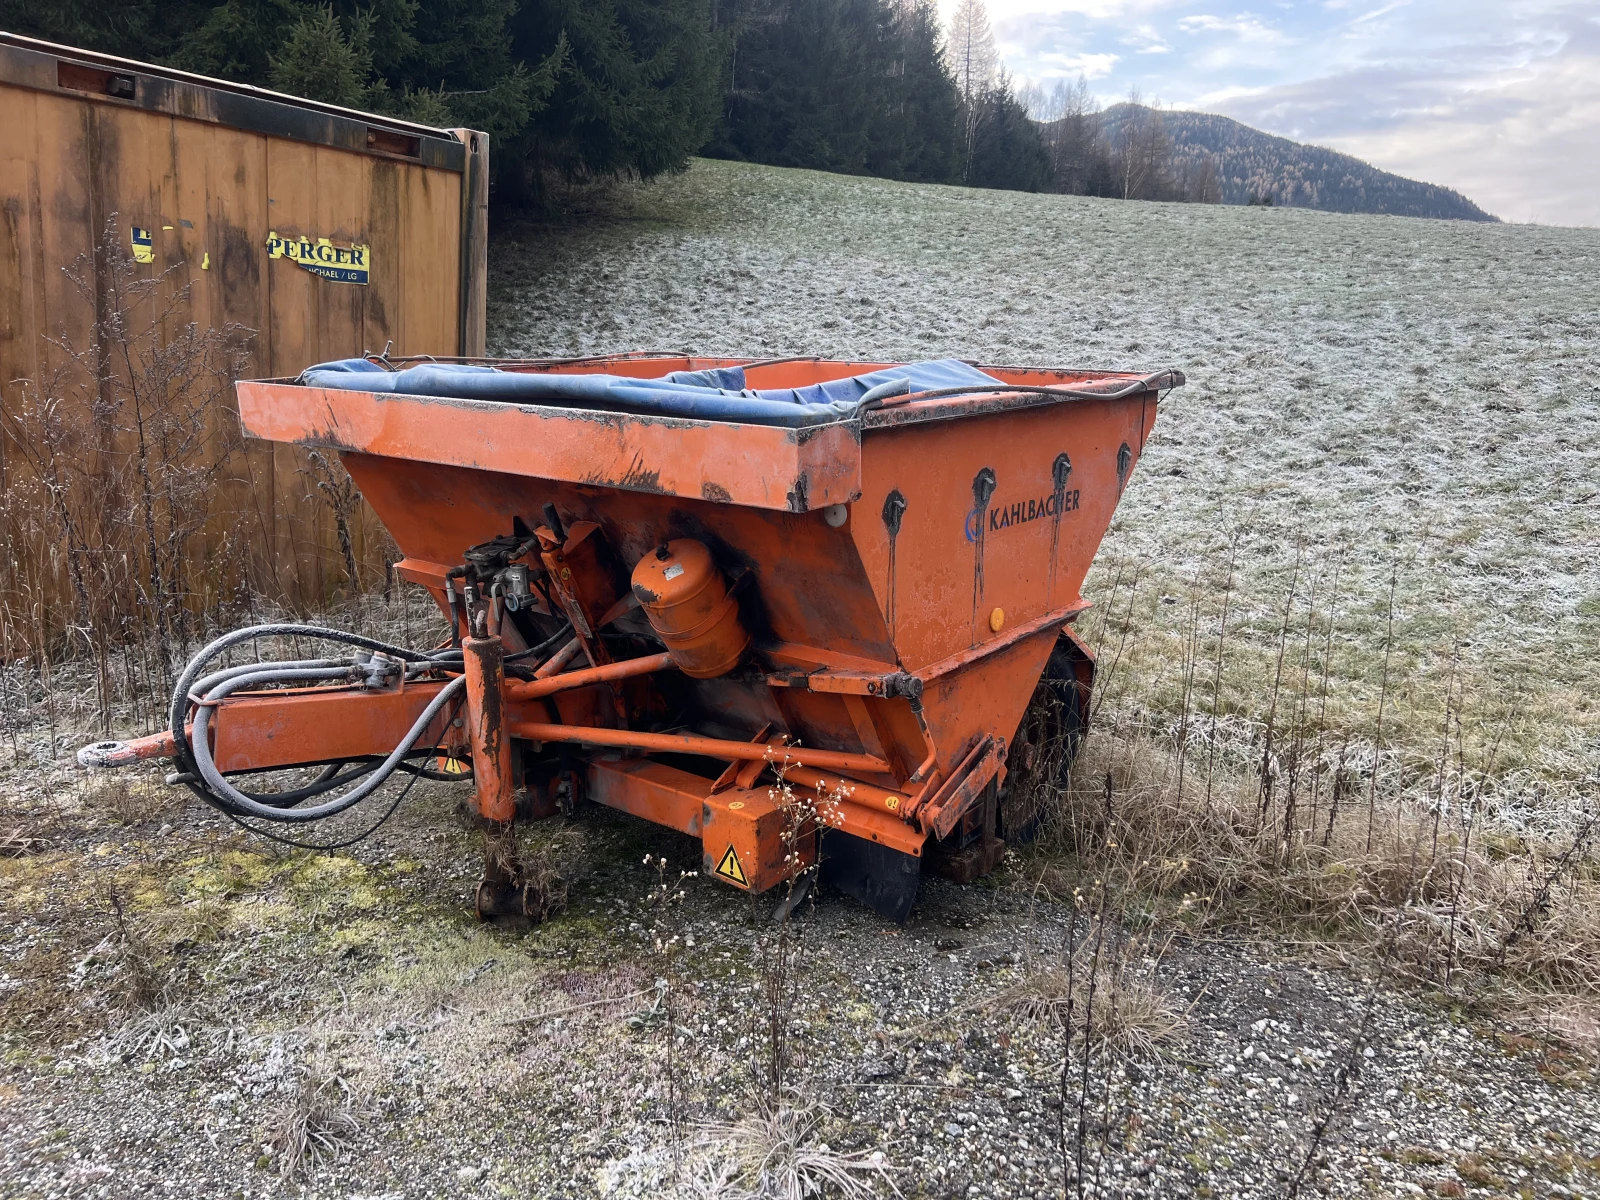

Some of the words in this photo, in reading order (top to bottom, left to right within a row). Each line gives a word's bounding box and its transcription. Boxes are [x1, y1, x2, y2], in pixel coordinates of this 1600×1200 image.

[268, 239, 364, 266] PERGER
[347, 272, 358, 280] LG
[989, 489, 1080, 532] KAHLBACHER
